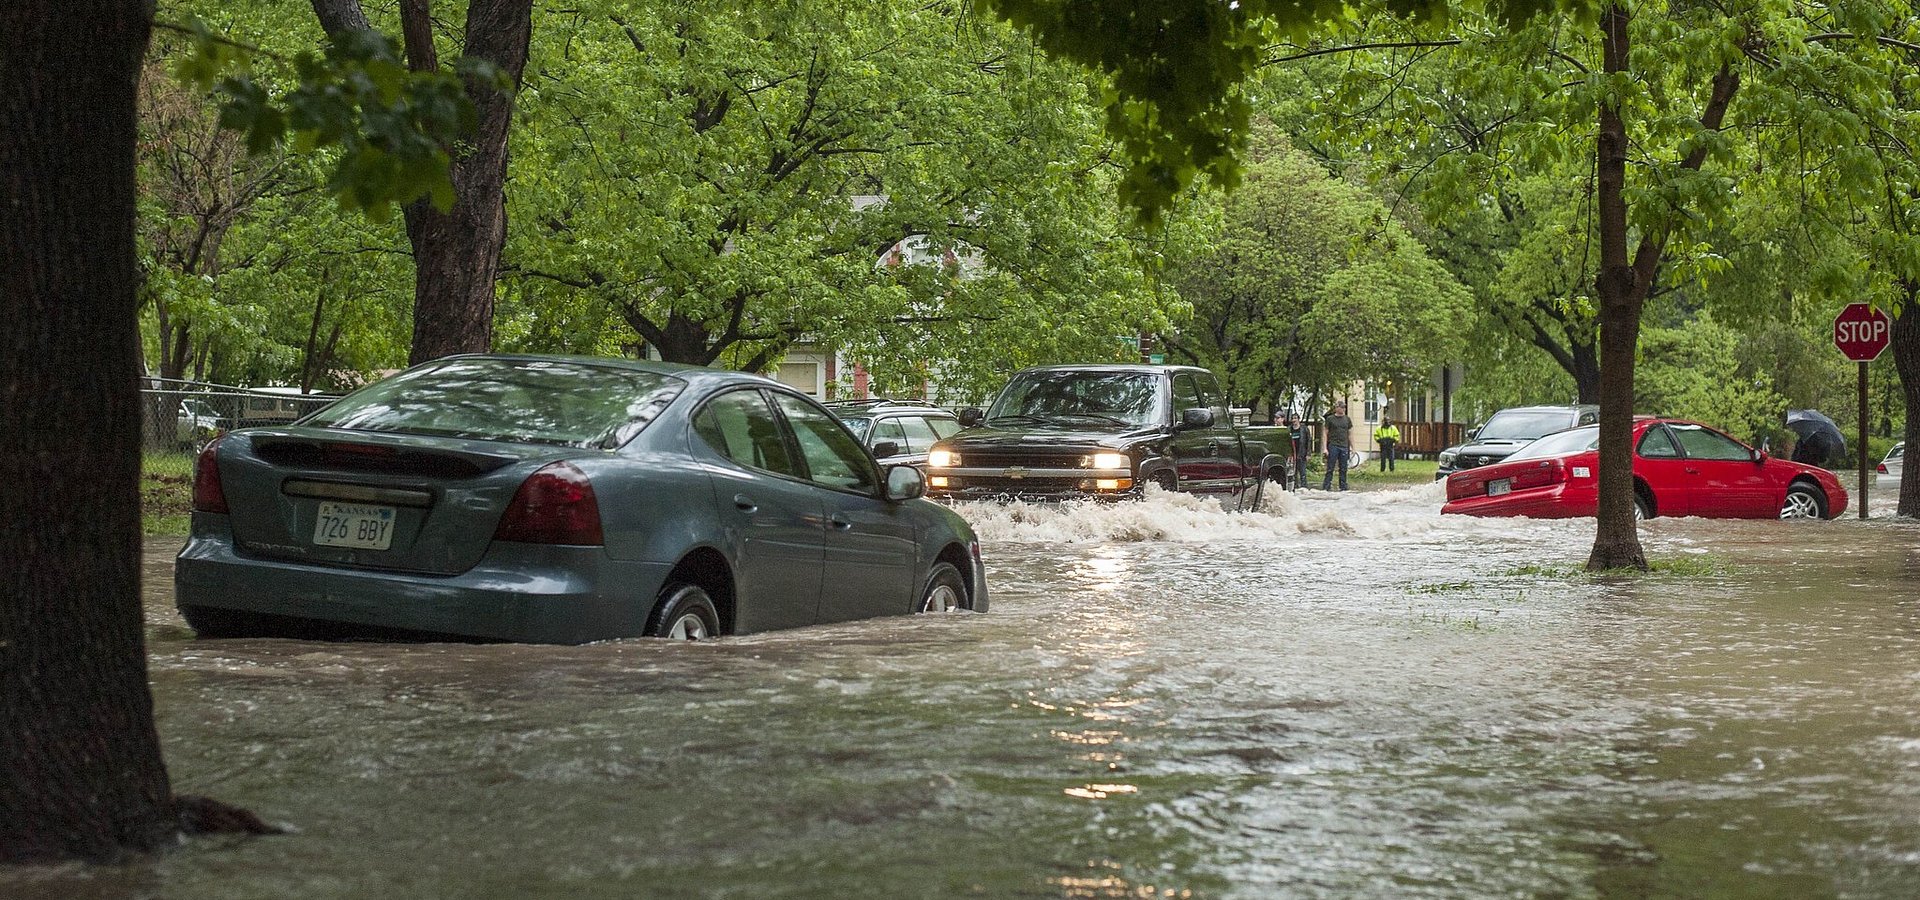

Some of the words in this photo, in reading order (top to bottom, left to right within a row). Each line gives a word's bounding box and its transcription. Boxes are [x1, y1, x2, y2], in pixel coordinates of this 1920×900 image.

[1837, 320, 1886, 343] STOP
[321, 516, 349, 539] 726
[358, 519, 390, 541] BBY
